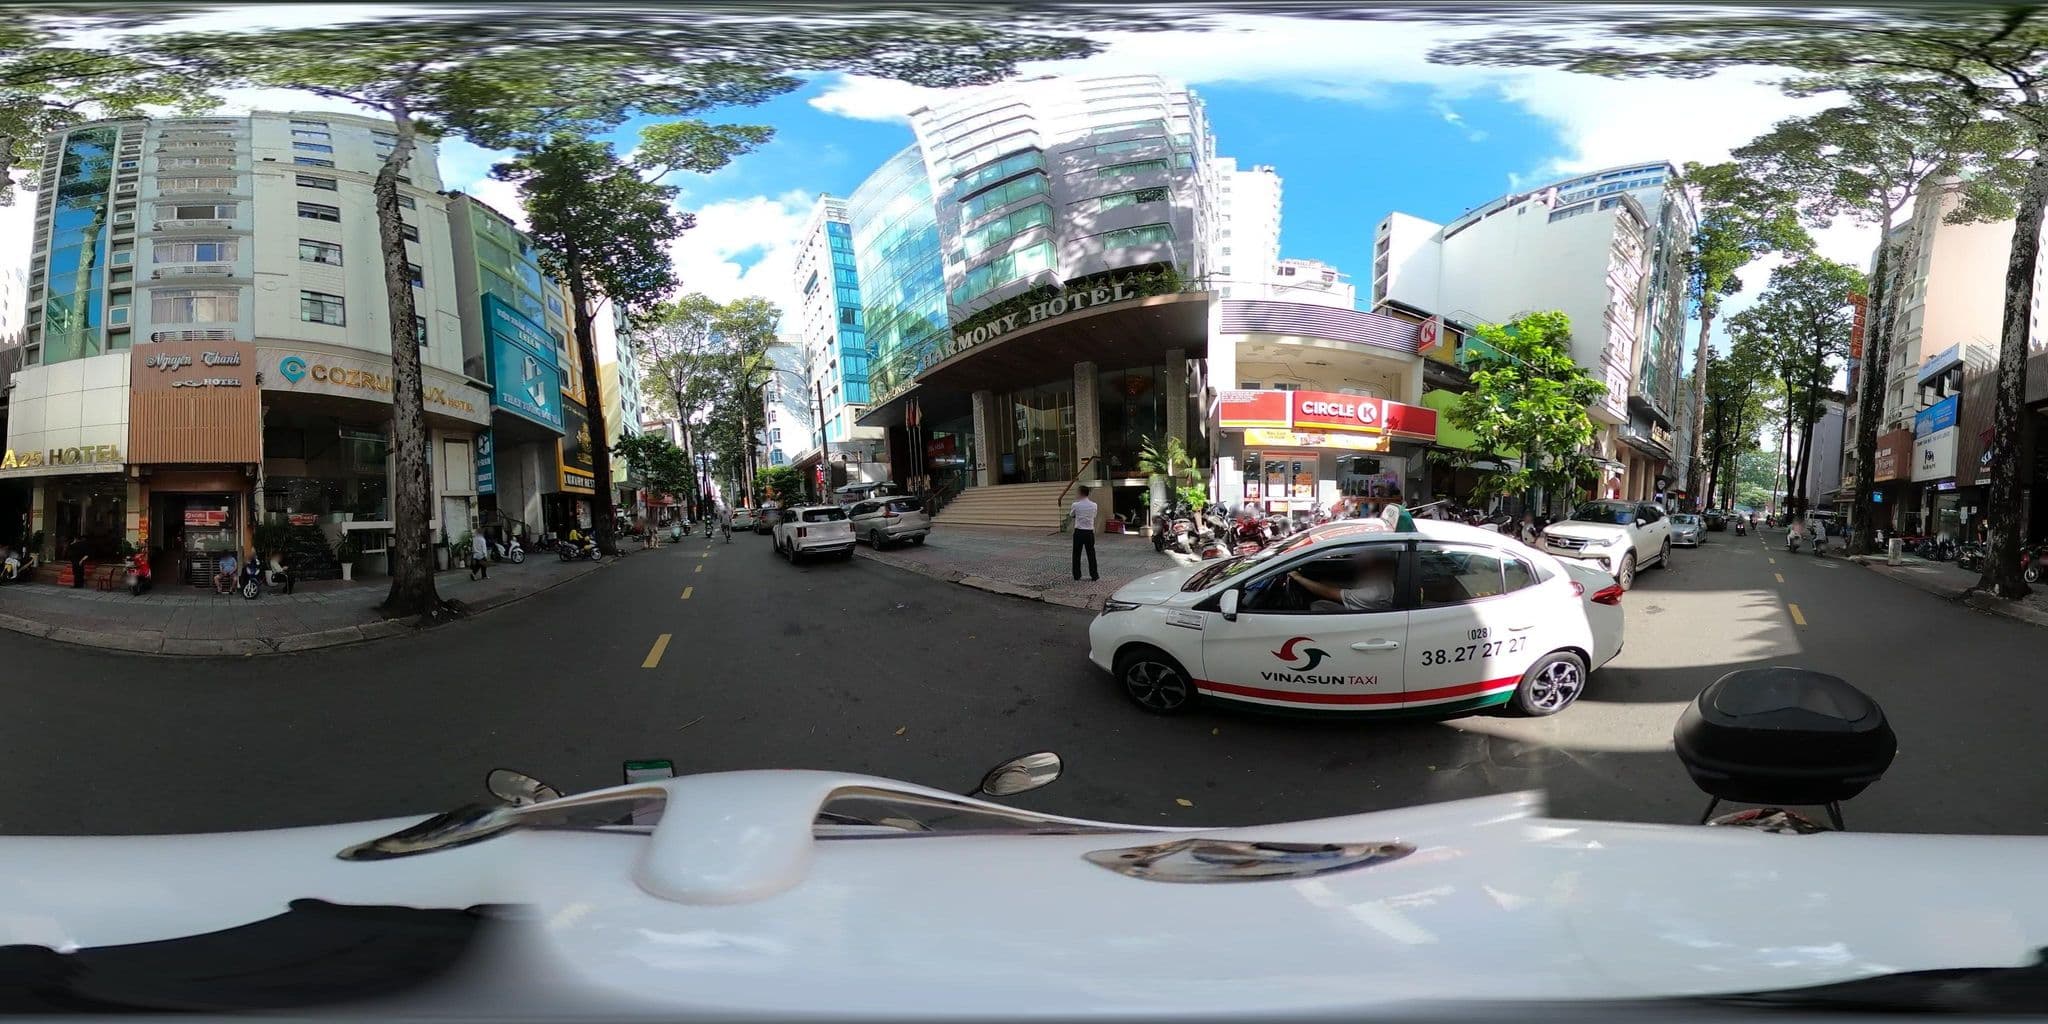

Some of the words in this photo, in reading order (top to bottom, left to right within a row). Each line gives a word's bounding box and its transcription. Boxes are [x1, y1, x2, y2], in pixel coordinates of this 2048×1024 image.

[922, 312, 1019, 369] HARMONY
[1027, 282, 1135, 324] HOTEL
[203, 378, 242, 387] HOTEL
[1301, 401, 1354, 418] CIRCLE
[0, 447, 45, 470] A25
[49, 444, 124, 465] HOTEL
[1467, 627, 1492, 640] (028)
[1421, 645, 1477, 666] 38.27
[1482, 641, 1503, 658] 27
[1508, 636, 1527, 653] 27
[1261, 671, 1345, 685] VINASUN
[1347, 675, 1378, 685] TAXI
